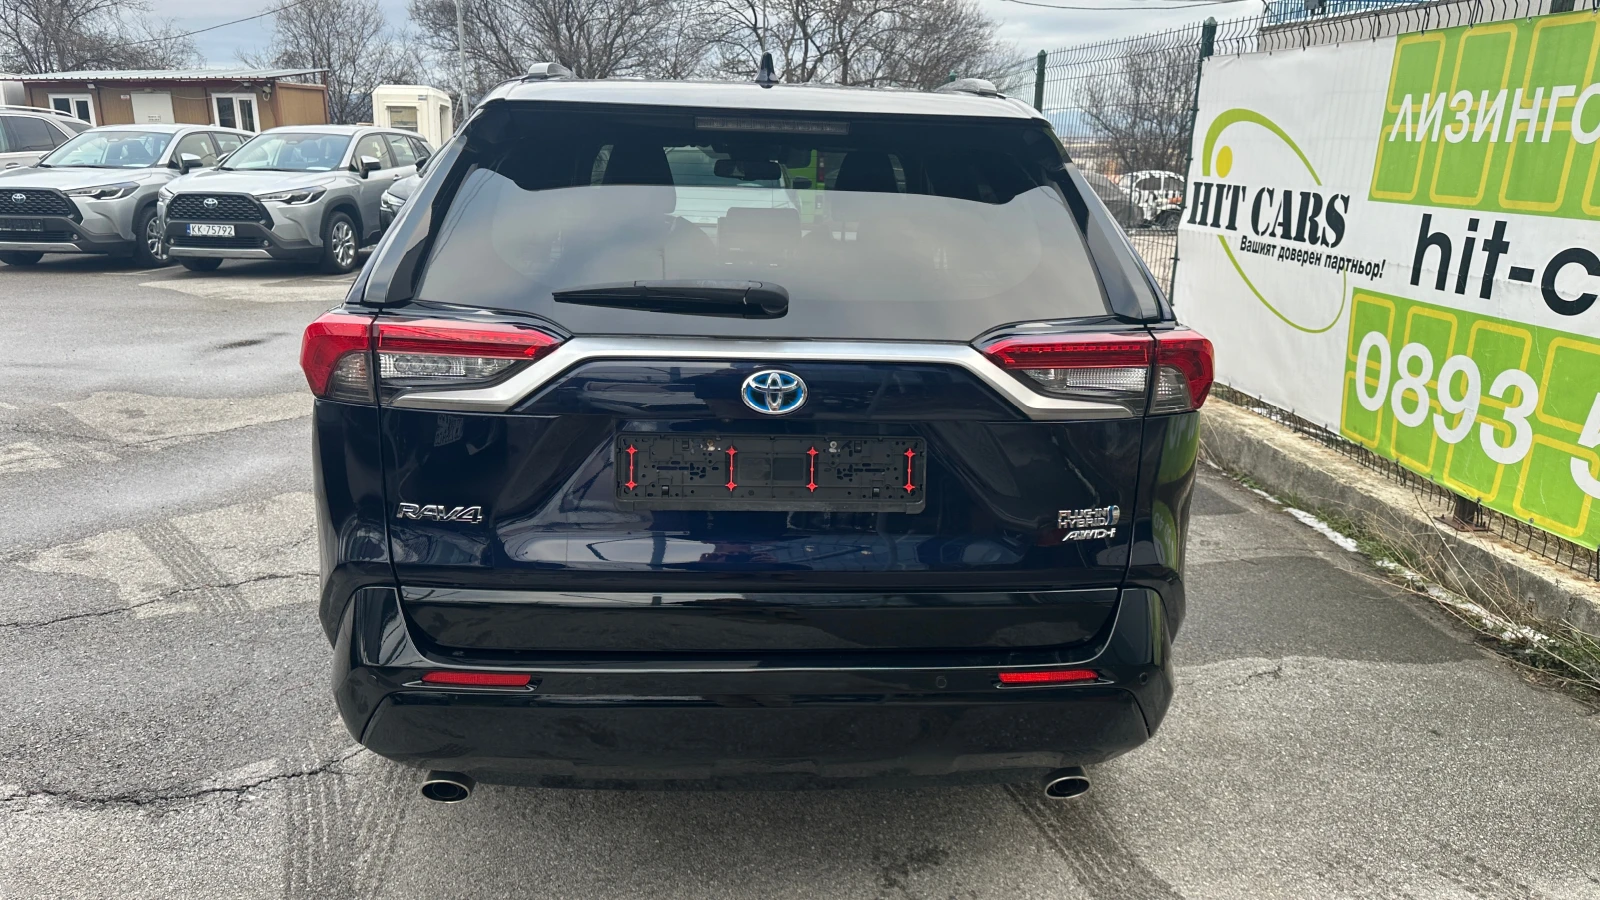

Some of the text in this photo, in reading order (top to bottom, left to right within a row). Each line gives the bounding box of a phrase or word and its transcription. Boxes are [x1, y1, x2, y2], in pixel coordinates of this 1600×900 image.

[191, 225, 233, 235] KK 75792
[1187, 182, 1350, 248] HIT CARS
[1240, 235, 1386, 281] Вашият доверен партньор!
[1410, 213, 1600, 316] hit-c
[1356, 331, 1539, 464] 0893
[396, 502, 482, 523] RAV4
[1058, 508, 1109, 518] PLUG-IN
[1058, 518, 1106, 529] HYBRID
